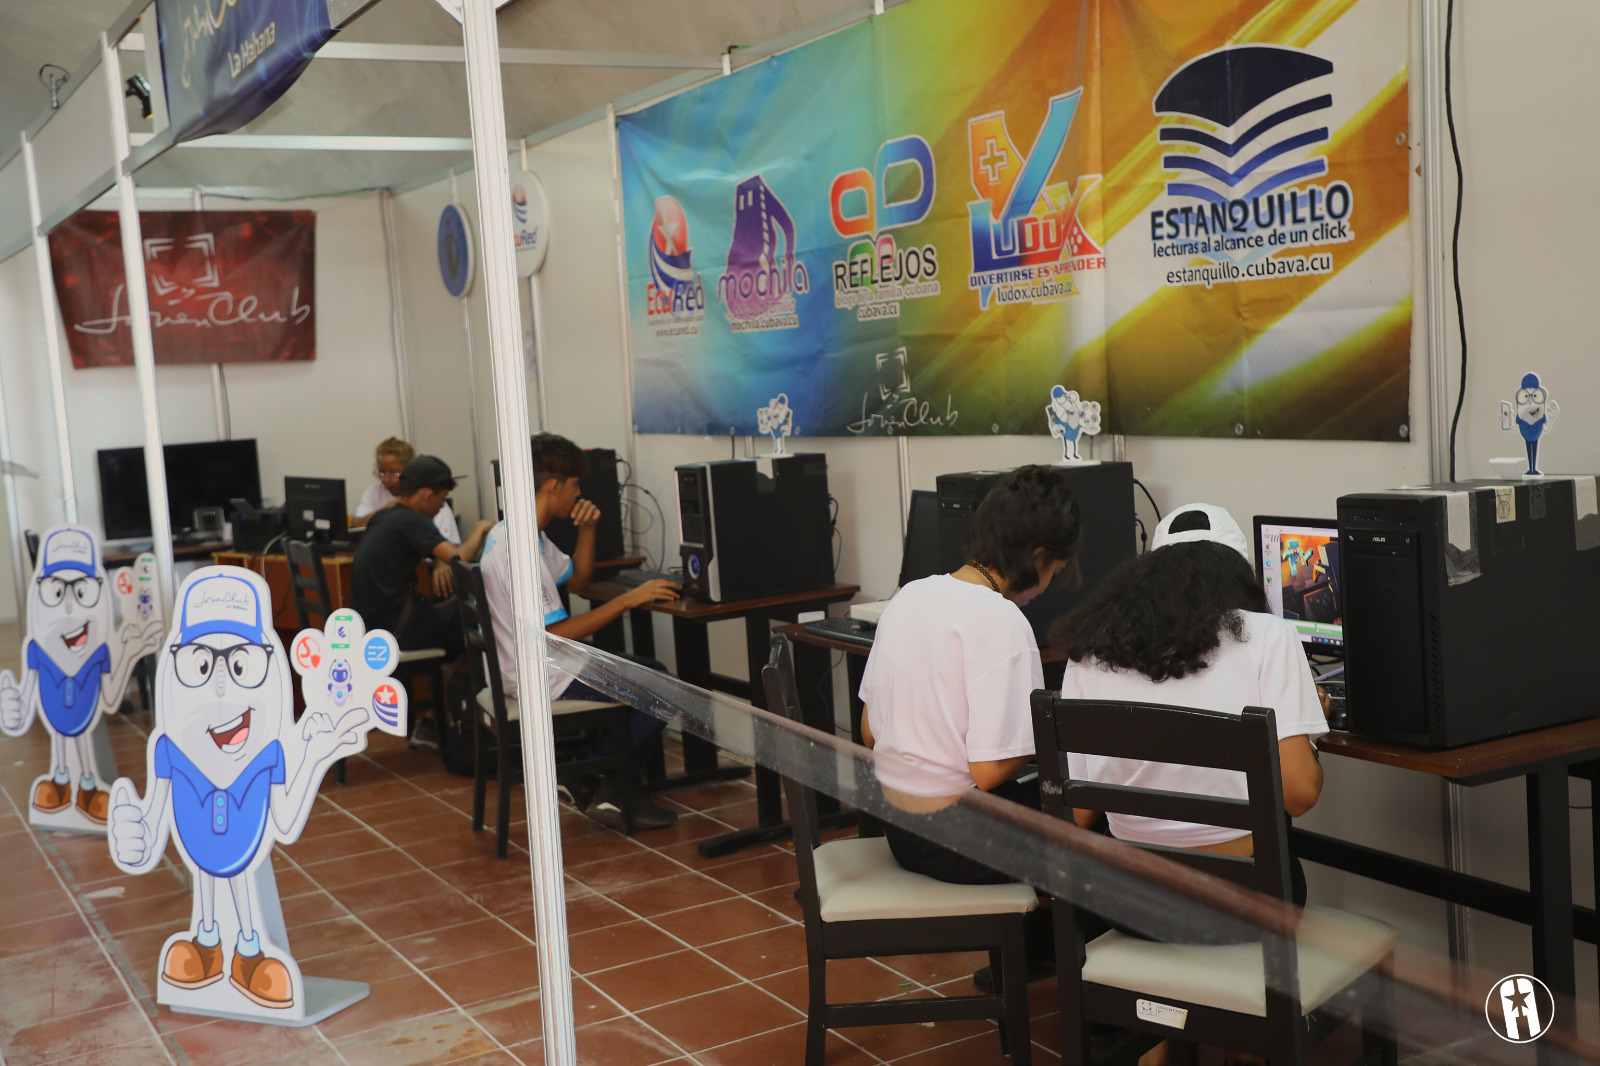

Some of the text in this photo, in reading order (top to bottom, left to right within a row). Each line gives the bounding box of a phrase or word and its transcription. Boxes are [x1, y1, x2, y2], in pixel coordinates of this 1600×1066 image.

[228, 51, 241, 78] La
[241, 21, 276, 67] Habana
[1151, 184, 1350, 241] ESTANQUILLO
[1153, 220, 1347, 258] lecturas al alcance de un click
[718, 260, 808, 301] mochila
[834, 247, 937, 291] REFLEJOS
[970, 257, 1106, 287] DIVERTIRSE ES APRENDER
[1166, 256, 1330, 285] estanquillo.cubava.cu
[73, 283, 311, 335] JvenClub
[647, 274, 705, 316] EcuRed
